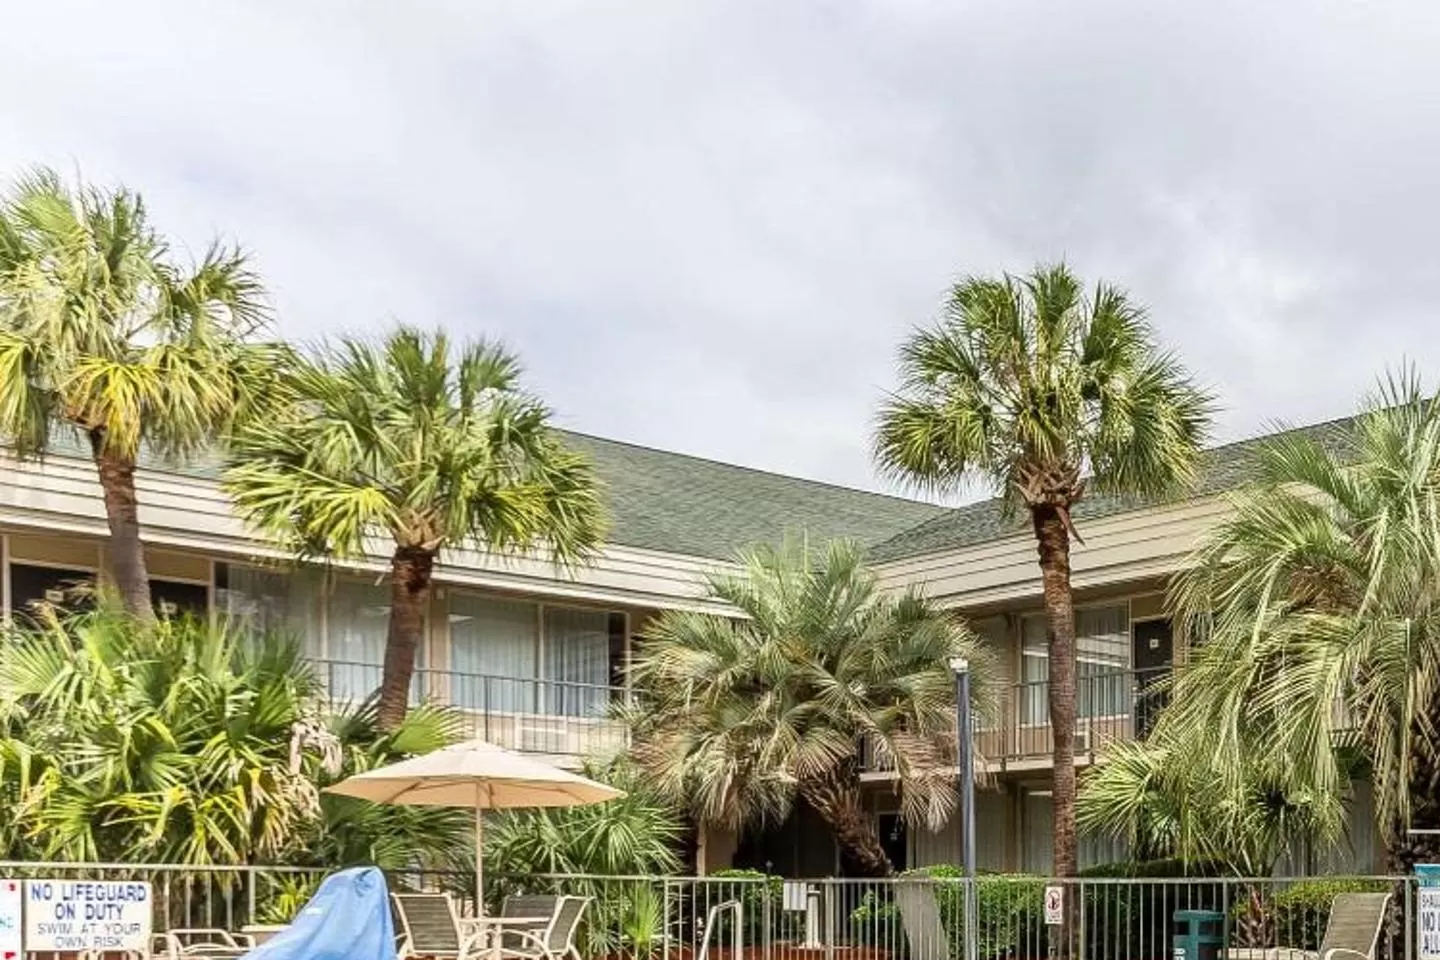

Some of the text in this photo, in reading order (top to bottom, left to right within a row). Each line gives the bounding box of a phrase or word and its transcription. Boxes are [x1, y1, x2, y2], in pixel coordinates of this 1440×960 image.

[32, 883, 146, 901] NO LIFEGUARD
[55, 904, 124, 919] ON DUTY
[38, 923, 140, 935] SWIM AT YOUR
[1422, 912, 1434, 931] NO
[55, 936, 124, 948] OWN RISK
